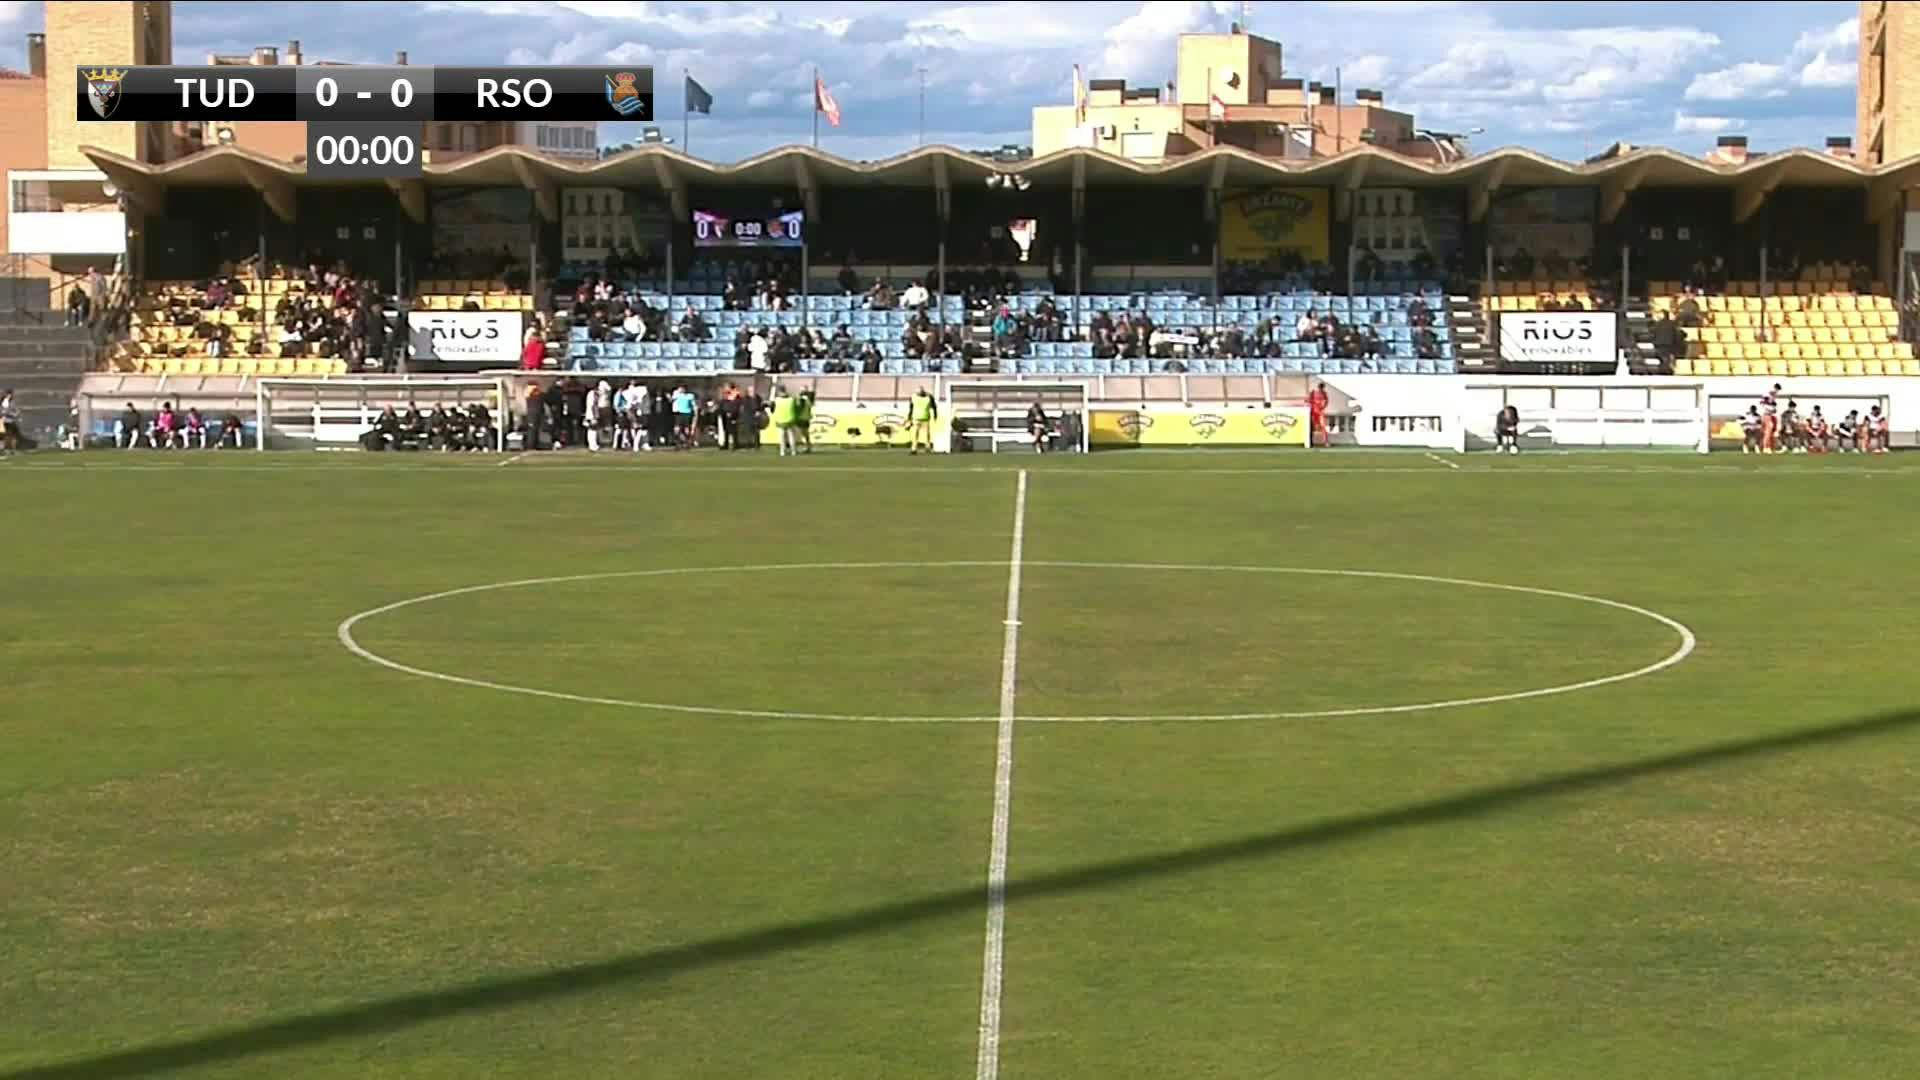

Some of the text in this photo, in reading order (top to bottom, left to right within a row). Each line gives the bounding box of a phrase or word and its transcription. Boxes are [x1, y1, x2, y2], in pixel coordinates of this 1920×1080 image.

[697, 220, 800, 239] 0 0:00 0
